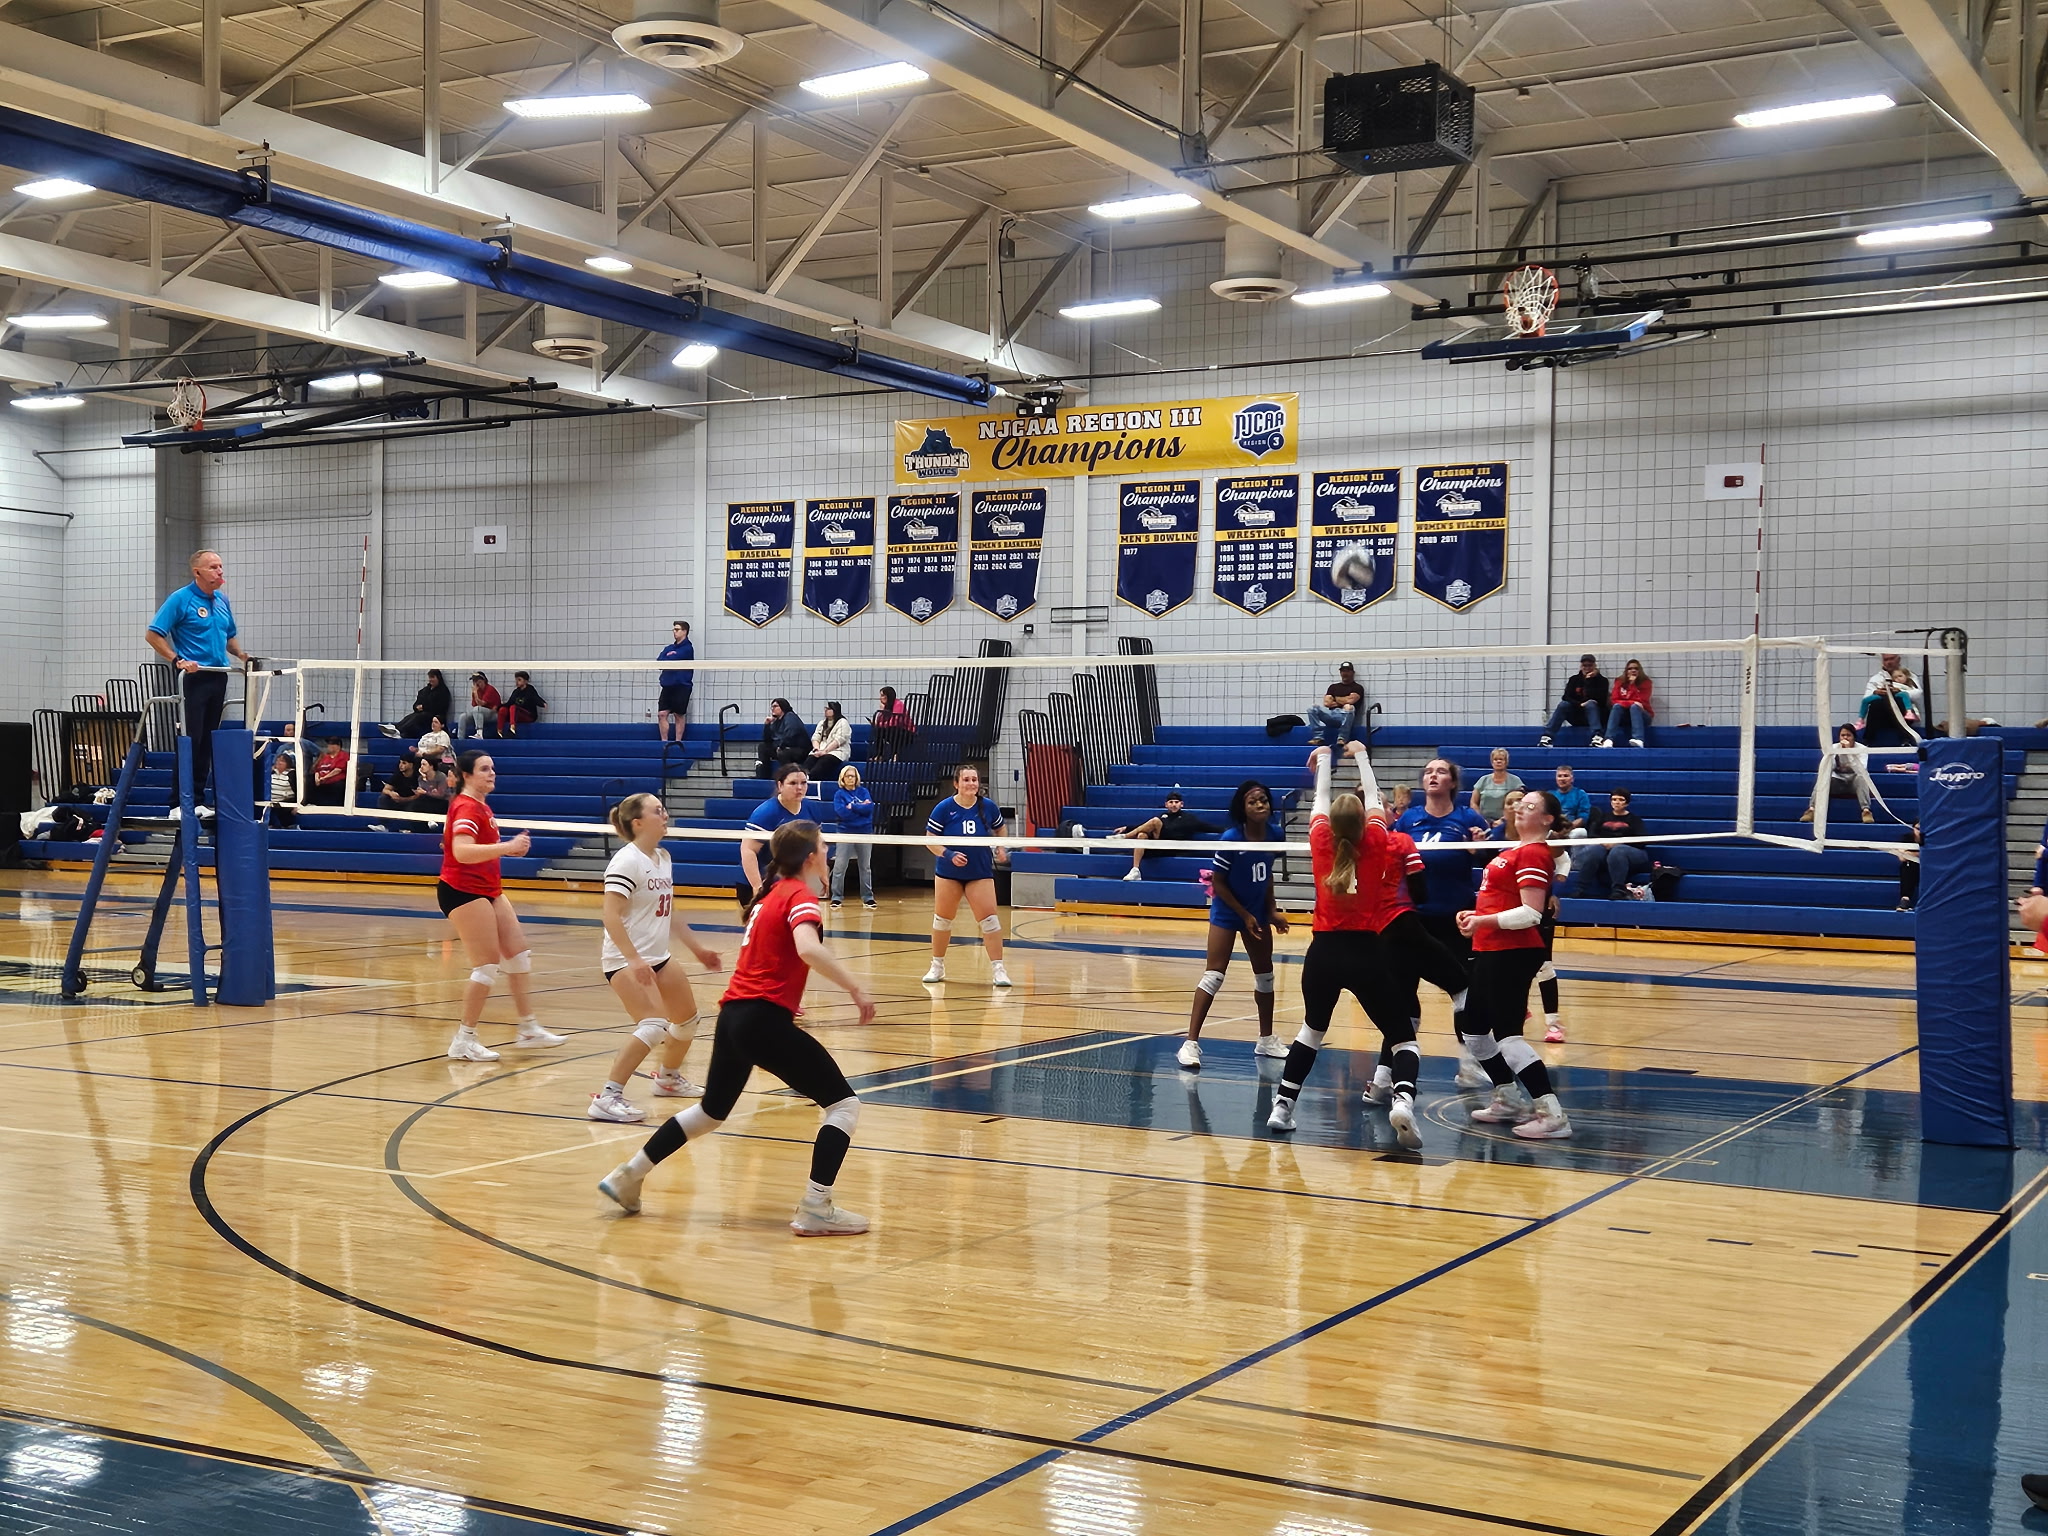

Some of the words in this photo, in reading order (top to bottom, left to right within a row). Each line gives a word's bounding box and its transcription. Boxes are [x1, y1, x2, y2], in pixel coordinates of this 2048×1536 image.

[979, 418, 1059, 440] NJCAA
[1066, 409, 1162, 434] REGION
[1170, 407, 1202, 427] III
[1234, 412, 1284, 440] NJCAA
[1272, 437, 1280, 446] 3
[991, 432, 1186, 472] Champions
[905, 453, 969, 471] THUNDER
[918, 468, 957, 477] WOLVES
[1329, 474, 1368, 483] REGION
[1371, 473, 1384, 481] III
[1433, 469, 1474, 478] REGION
[1477, 467, 1490, 475] III
[1135, 485, 1170, 493] REGION
[1231, 481, 1268, 489] REGION
[1272, 479, 1284, 487] III
[1316, 482, 1396, 497] Champions
[1419, 476, 1503, 492] Champions
[1021, 492, 1032, 500] III
[1123, 492, 1196, 507] Champions
[1219, 487, 1296, 503] Champions
[819, 502, 849, 510] REGION
[901, 498, 933, 506] REGION
[891, 505, 956, 519] Champions
[975, 500, 1043, 516] Champions
[731, 513, 791, 526] Champions
[809, 509, 872, 524] Champions
[1325, 524, 1386, 534] WRESTLING
[1416, 522, 1454, 531] WOMEN'S
[1457, 519, 1505, 529] VOLLEYBALL
[1121, 534, 1150, 543] MEN'S
[1153, 532, 1198, 542] BOWLING
[1227, 529, 1285, 539] WRESTLING
[1441, 535, 1458, 543] 2011
[912, 543, 958, 551] BASKETBALL
[1316, 540, 1332, 548] 2012
[1377, 537, 1394, 545] 2017
[740, 550, 781, 558] BASEBALL
[829, 547, 850, 556] GOLF
[1124, 548, 1138, 556] 1977
[1314, 560, 1332, 568] 2022
[730, 571, 743, 579] 2017
[1929, 768, 1985, 782] Jaypro
[962, 820, 976, 834] 18
[1421, 831, 1442, 842] 14
[1251, 862, 1267, 883] 10
[655, 893, 671, 917] 33
